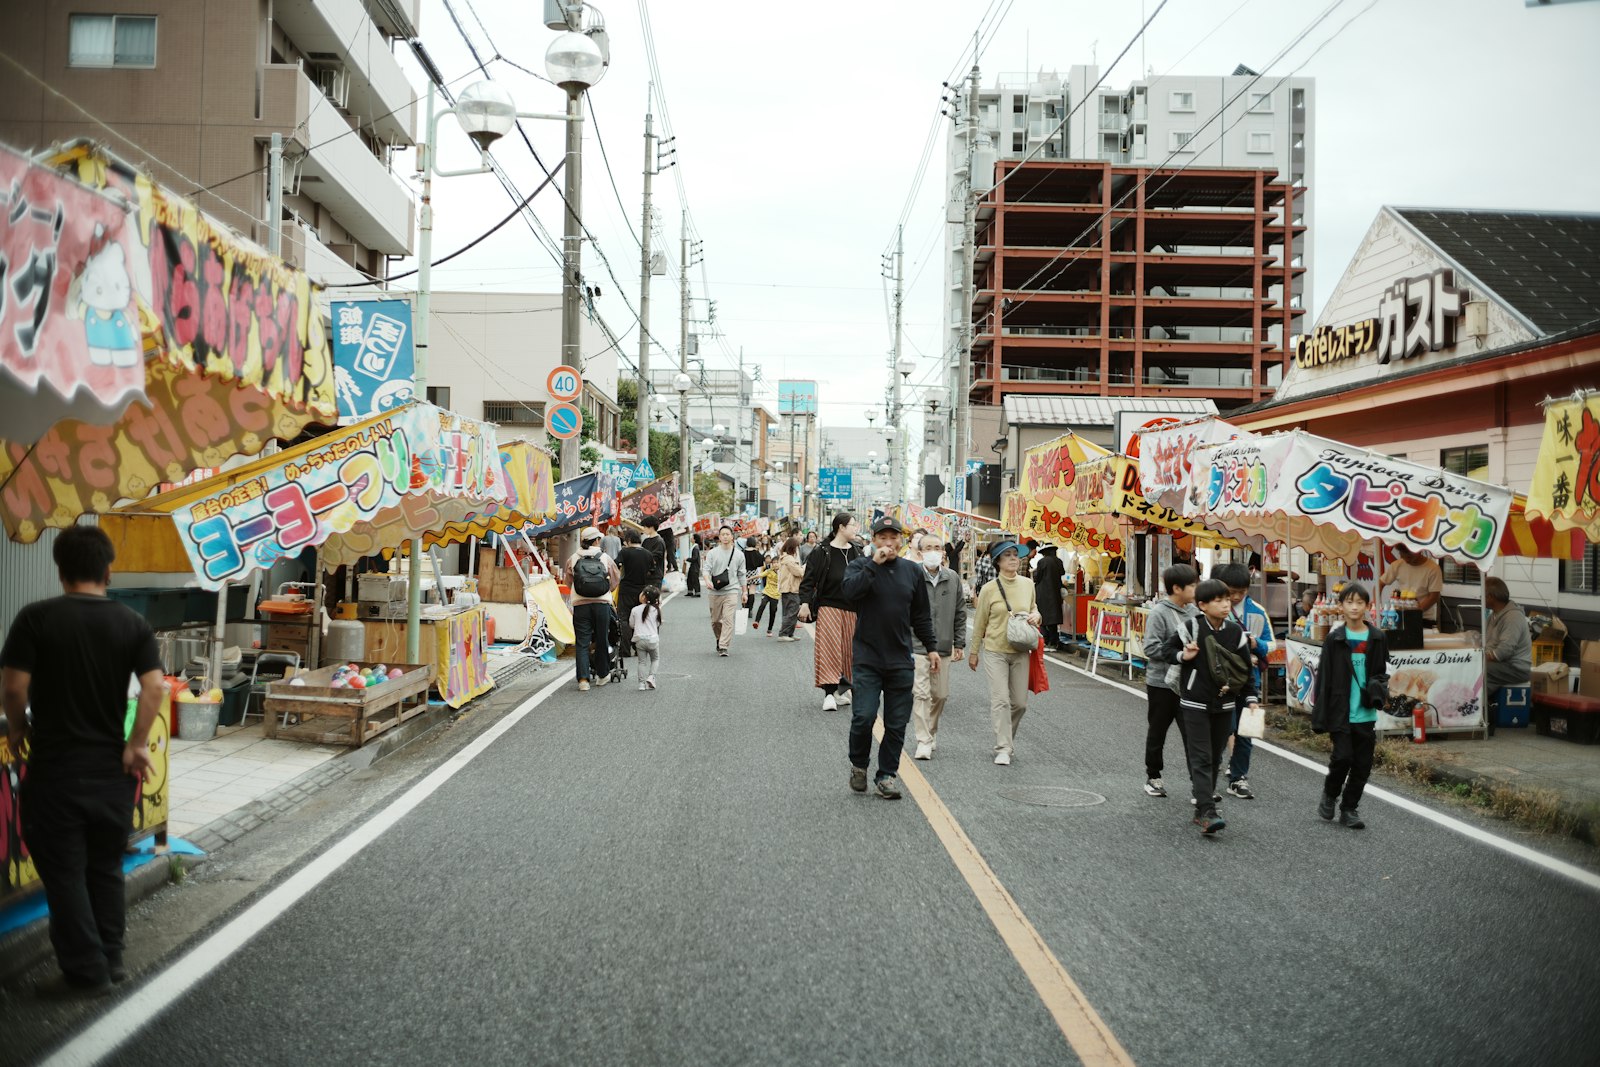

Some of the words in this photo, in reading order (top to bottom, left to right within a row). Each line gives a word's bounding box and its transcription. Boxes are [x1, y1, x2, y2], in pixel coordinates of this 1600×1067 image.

[1376, 267, 1460, 363] ガスト
[362, 320, 401, 373] まつり
[555, 376, 575, 392] 40
[1207, 456, 1268, 512] タピオカ
[1319, 449, 1415, 482] Tapioca
[1418, 473, 1492, 504] Drink
[1552, 408, 1580, 510] 味一番
[188, 427, 410, 582] ヨーヨーつり
[190, 475, 270, 523] 屋台の定番!
[1295, 461, 1497, 560] タピオカ
[1433, 652, 1473, 665] Drink
